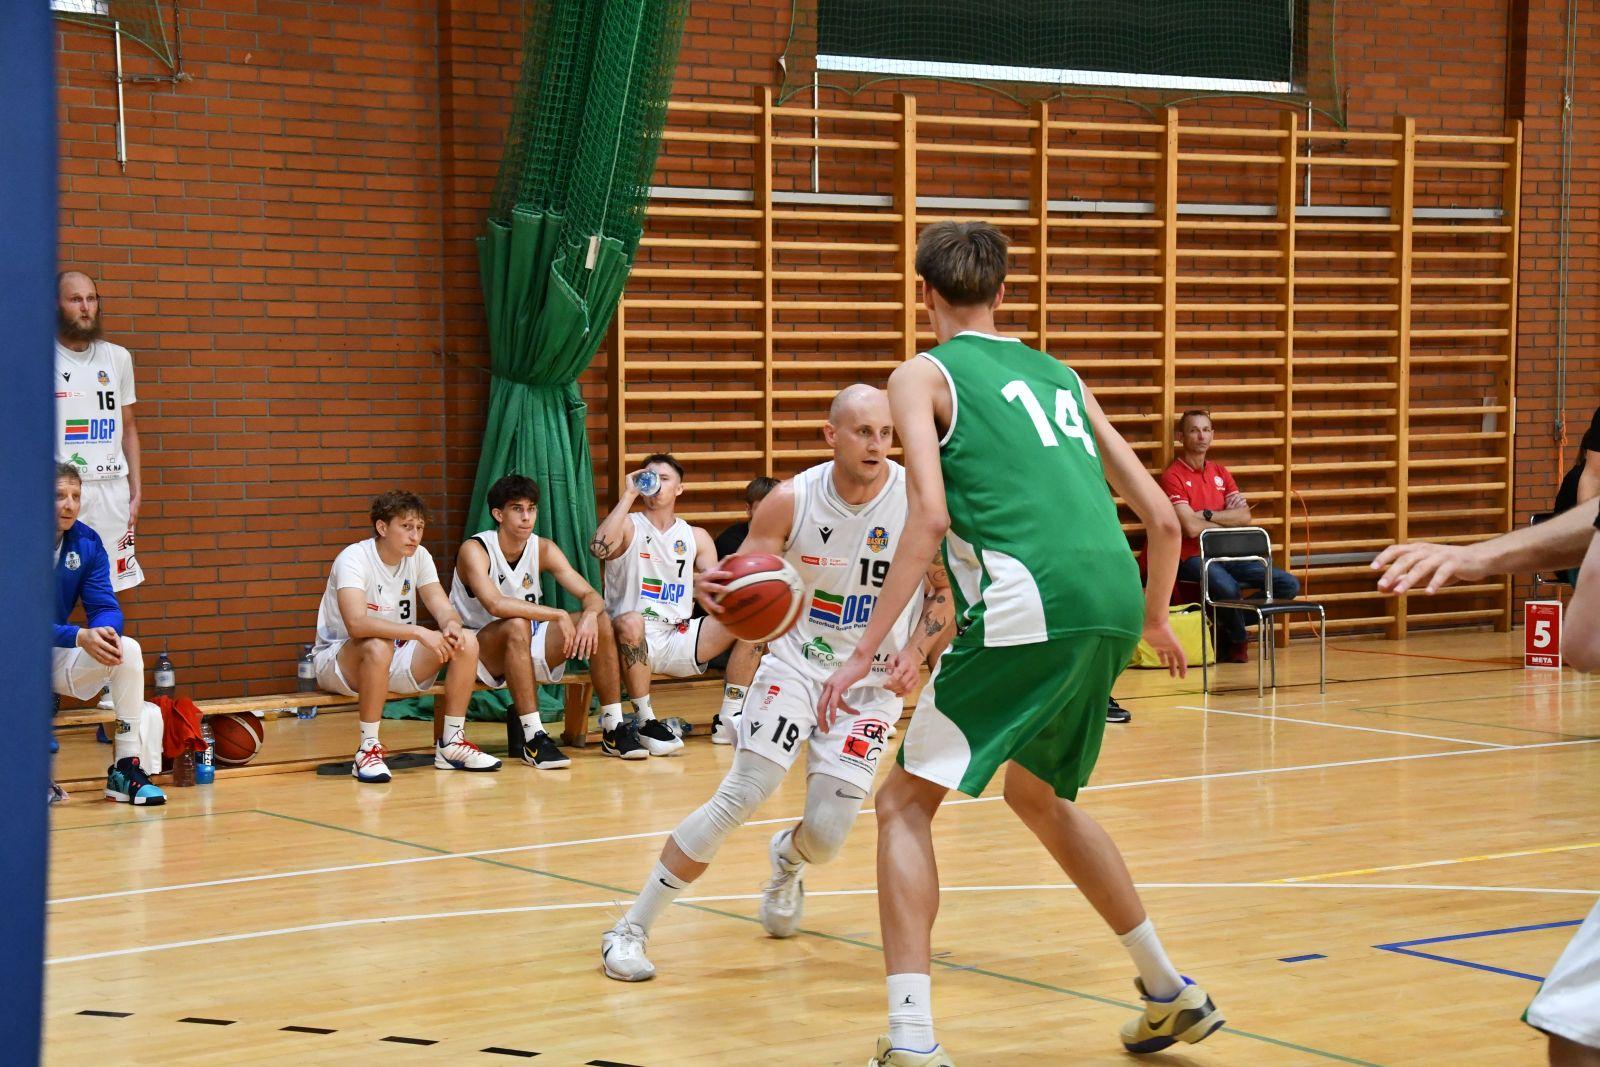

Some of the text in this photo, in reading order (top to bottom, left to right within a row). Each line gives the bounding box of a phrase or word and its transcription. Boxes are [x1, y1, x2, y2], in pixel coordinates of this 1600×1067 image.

[97, 391, 115, 410] 16
[1001, 380, 1096, 457] 14
[90, 419, 115, 440] DGP
[676, 560, 685, 577] 7
[860, 558, 890, 588] 19
[661, 583, 685, 603] DGP
[399, 600, 411, 619] 3
[842, 594, 878, 625] DG
[1533, 621, 1551, 648] 5
[1532, 656, 1552, 664] META
[771, 715, 799, 752] 19
